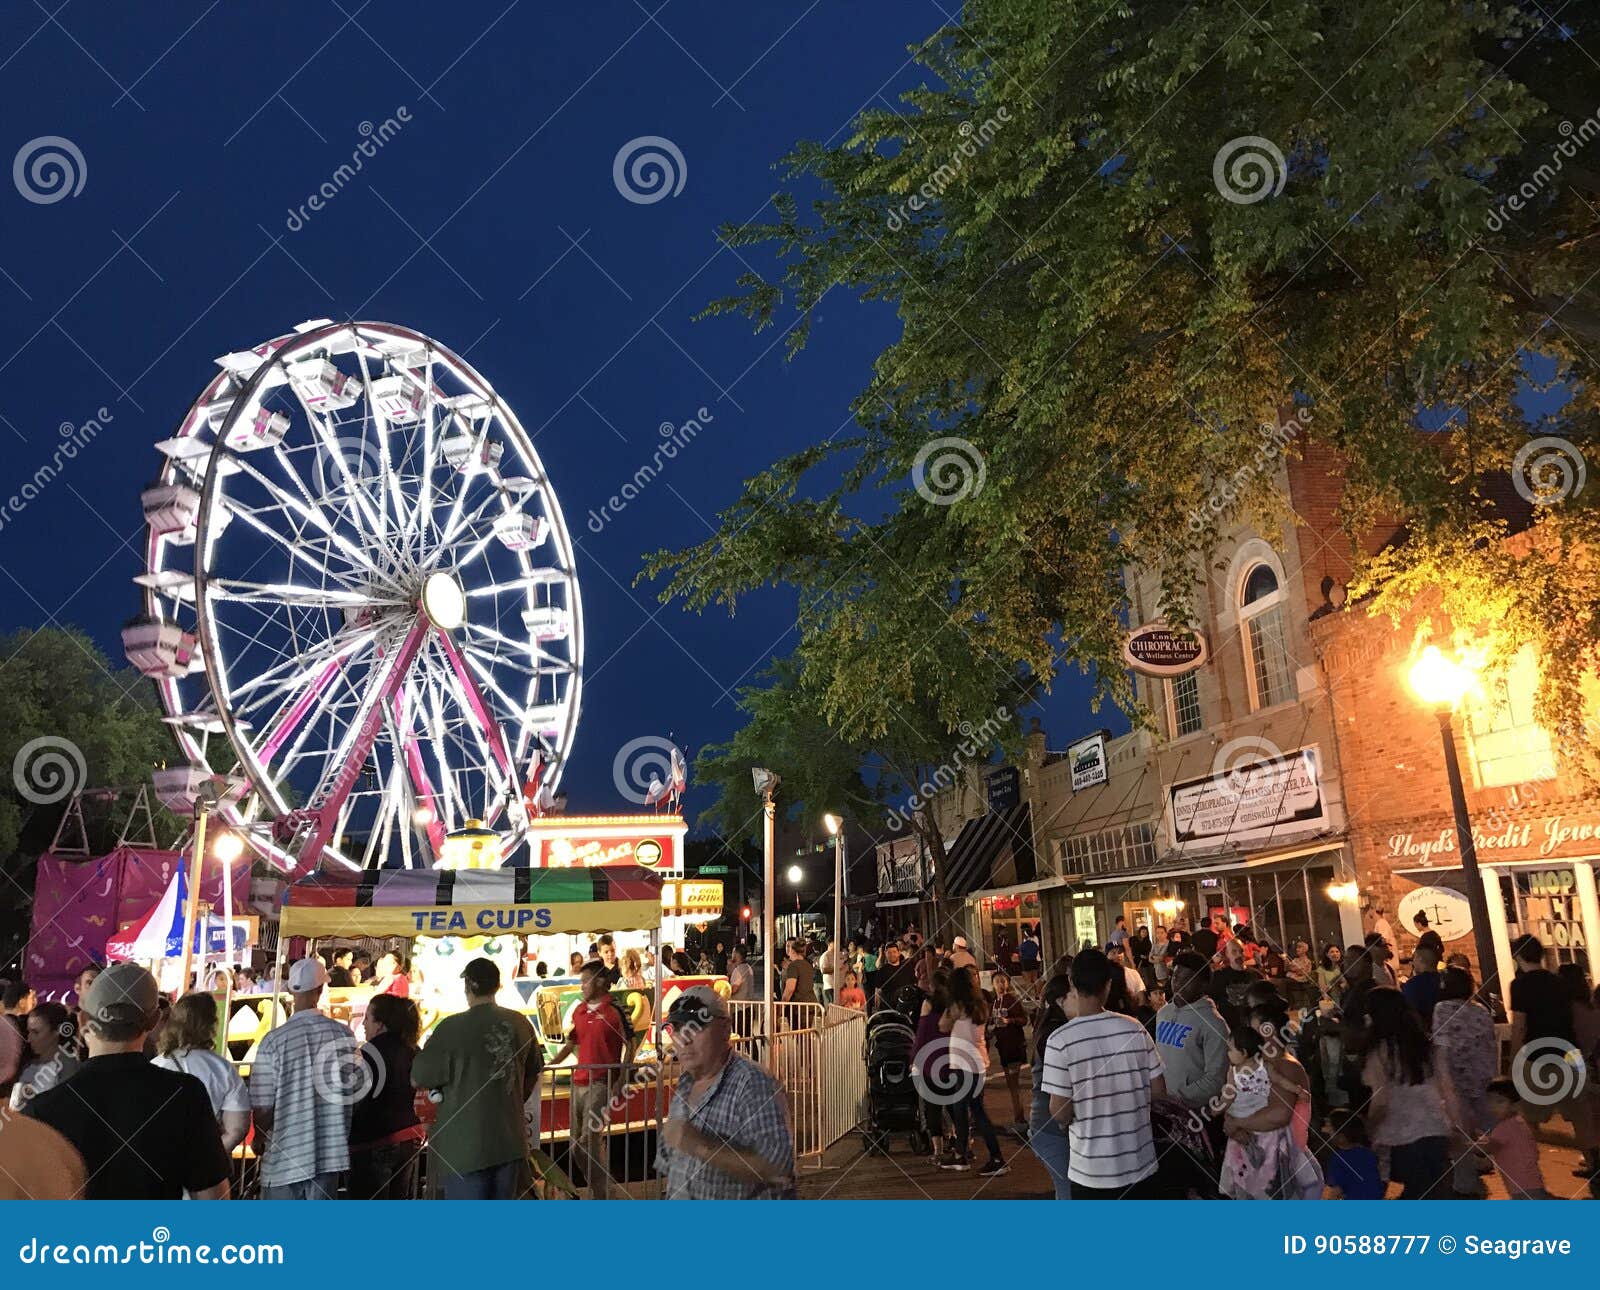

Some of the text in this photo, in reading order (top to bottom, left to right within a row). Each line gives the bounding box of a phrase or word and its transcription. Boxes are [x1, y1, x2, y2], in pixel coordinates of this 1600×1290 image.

[1130, 640, 1199, 651] CHIROPRACTIC
[1152, 633, 1178, 641] Enni
[1176, 804, 1191, 817] ENNIS
[1241, 783, 1272, 801] ELLNESS
[1387, 828, 1455, 864] Lloyd's
[411, 908, 552, 931] TEA CUPS
[1156, 1021, 1193, 1048] NIKE
